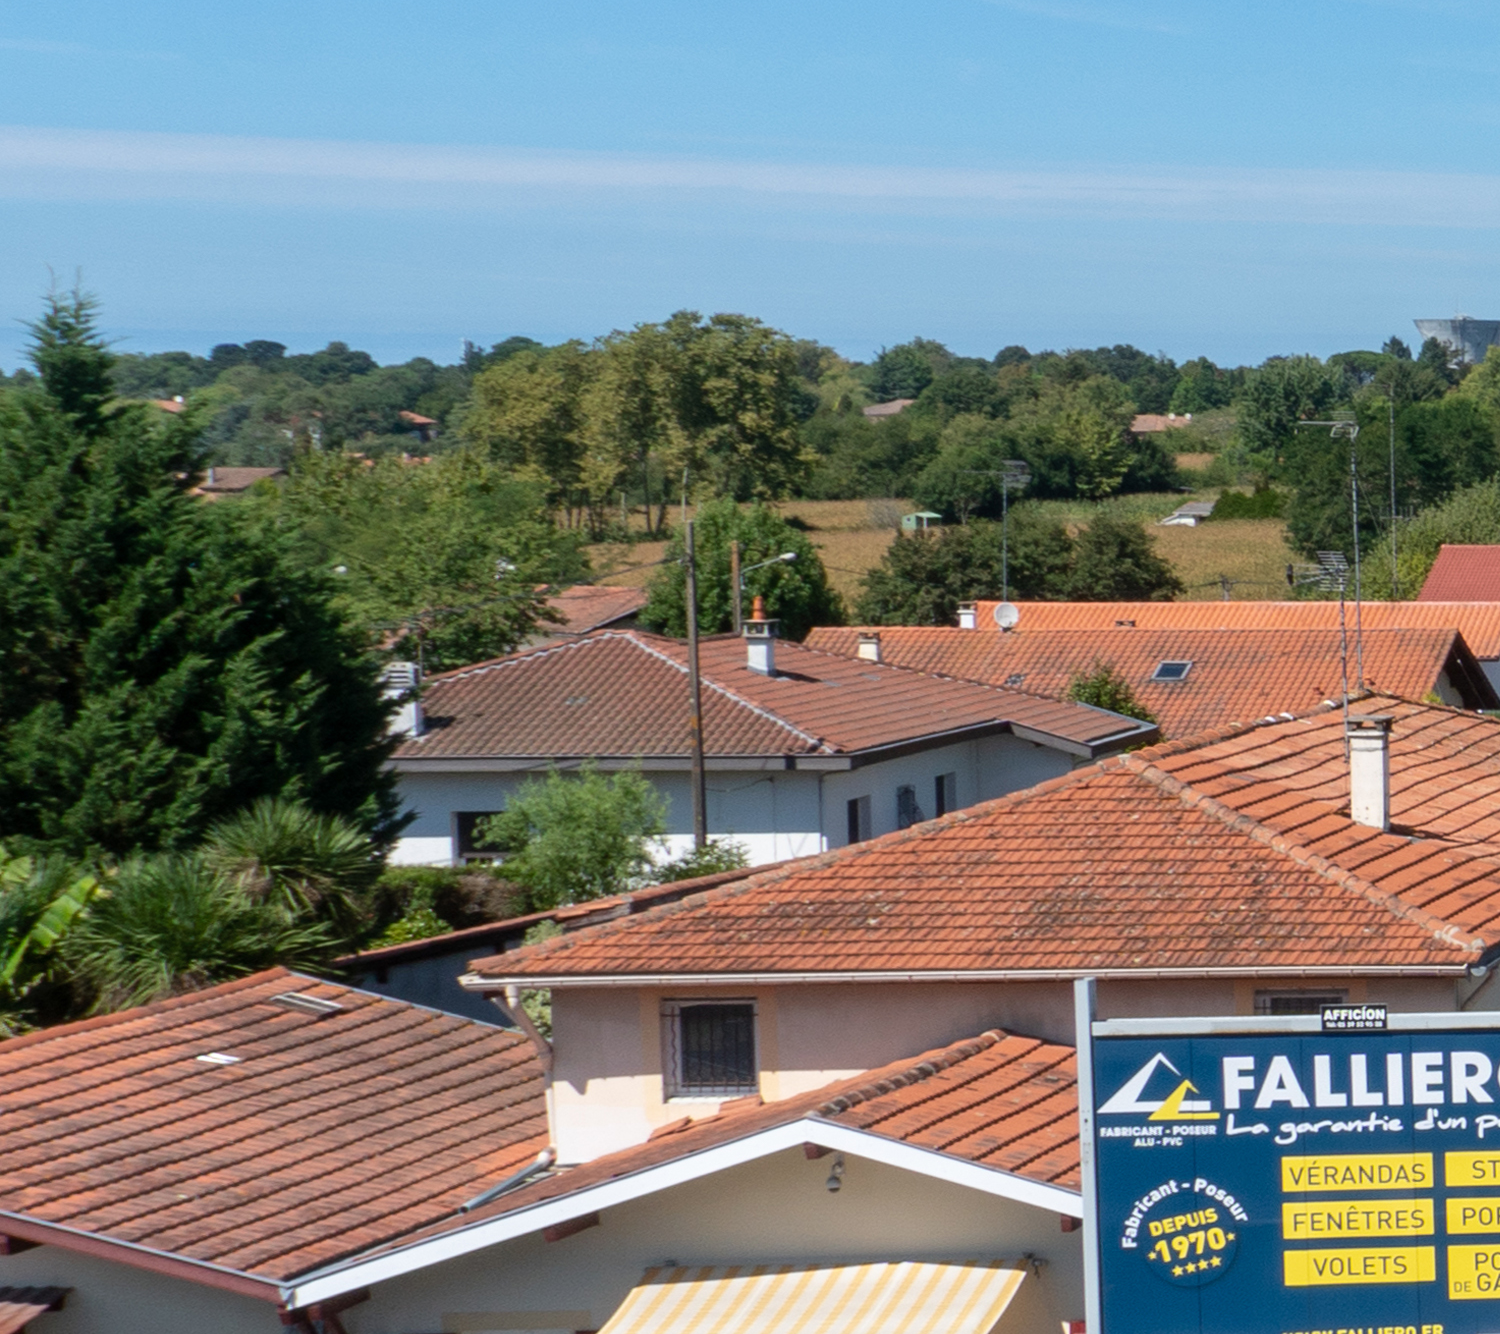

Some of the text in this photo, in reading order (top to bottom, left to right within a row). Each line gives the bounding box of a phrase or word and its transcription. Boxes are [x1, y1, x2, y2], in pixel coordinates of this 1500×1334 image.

[1099, 1125, 1164, 1137] FABRICANT
[1172, 1124, 1217, 1136] POSEUR
[1226, 1113, 1270, 1136] La
[1274, 1111, 1404, 1145] garantie
[1414, 1107, 1467, 1130] d'un
[1133, 1137, 1155, 1147] ALU
[1162, 1136, 1183, 1147] PVC
[1289, 1160, 1426, 1186] VÉRANDAS
[1121, 1178, 1179, 1249] Fabricant
[1194, 1177, 1248, 1223] Poseur
[1148, 1208, 1219, 1237] DEPUIS
[1293, 1205, 1425, 1232] FENÊTRES
[1153, 1226, 1227, 1264] 1970
[1313, 1255, 1408, 1276] VOLETS
[1454, 1280, 1472, 1293] DE
